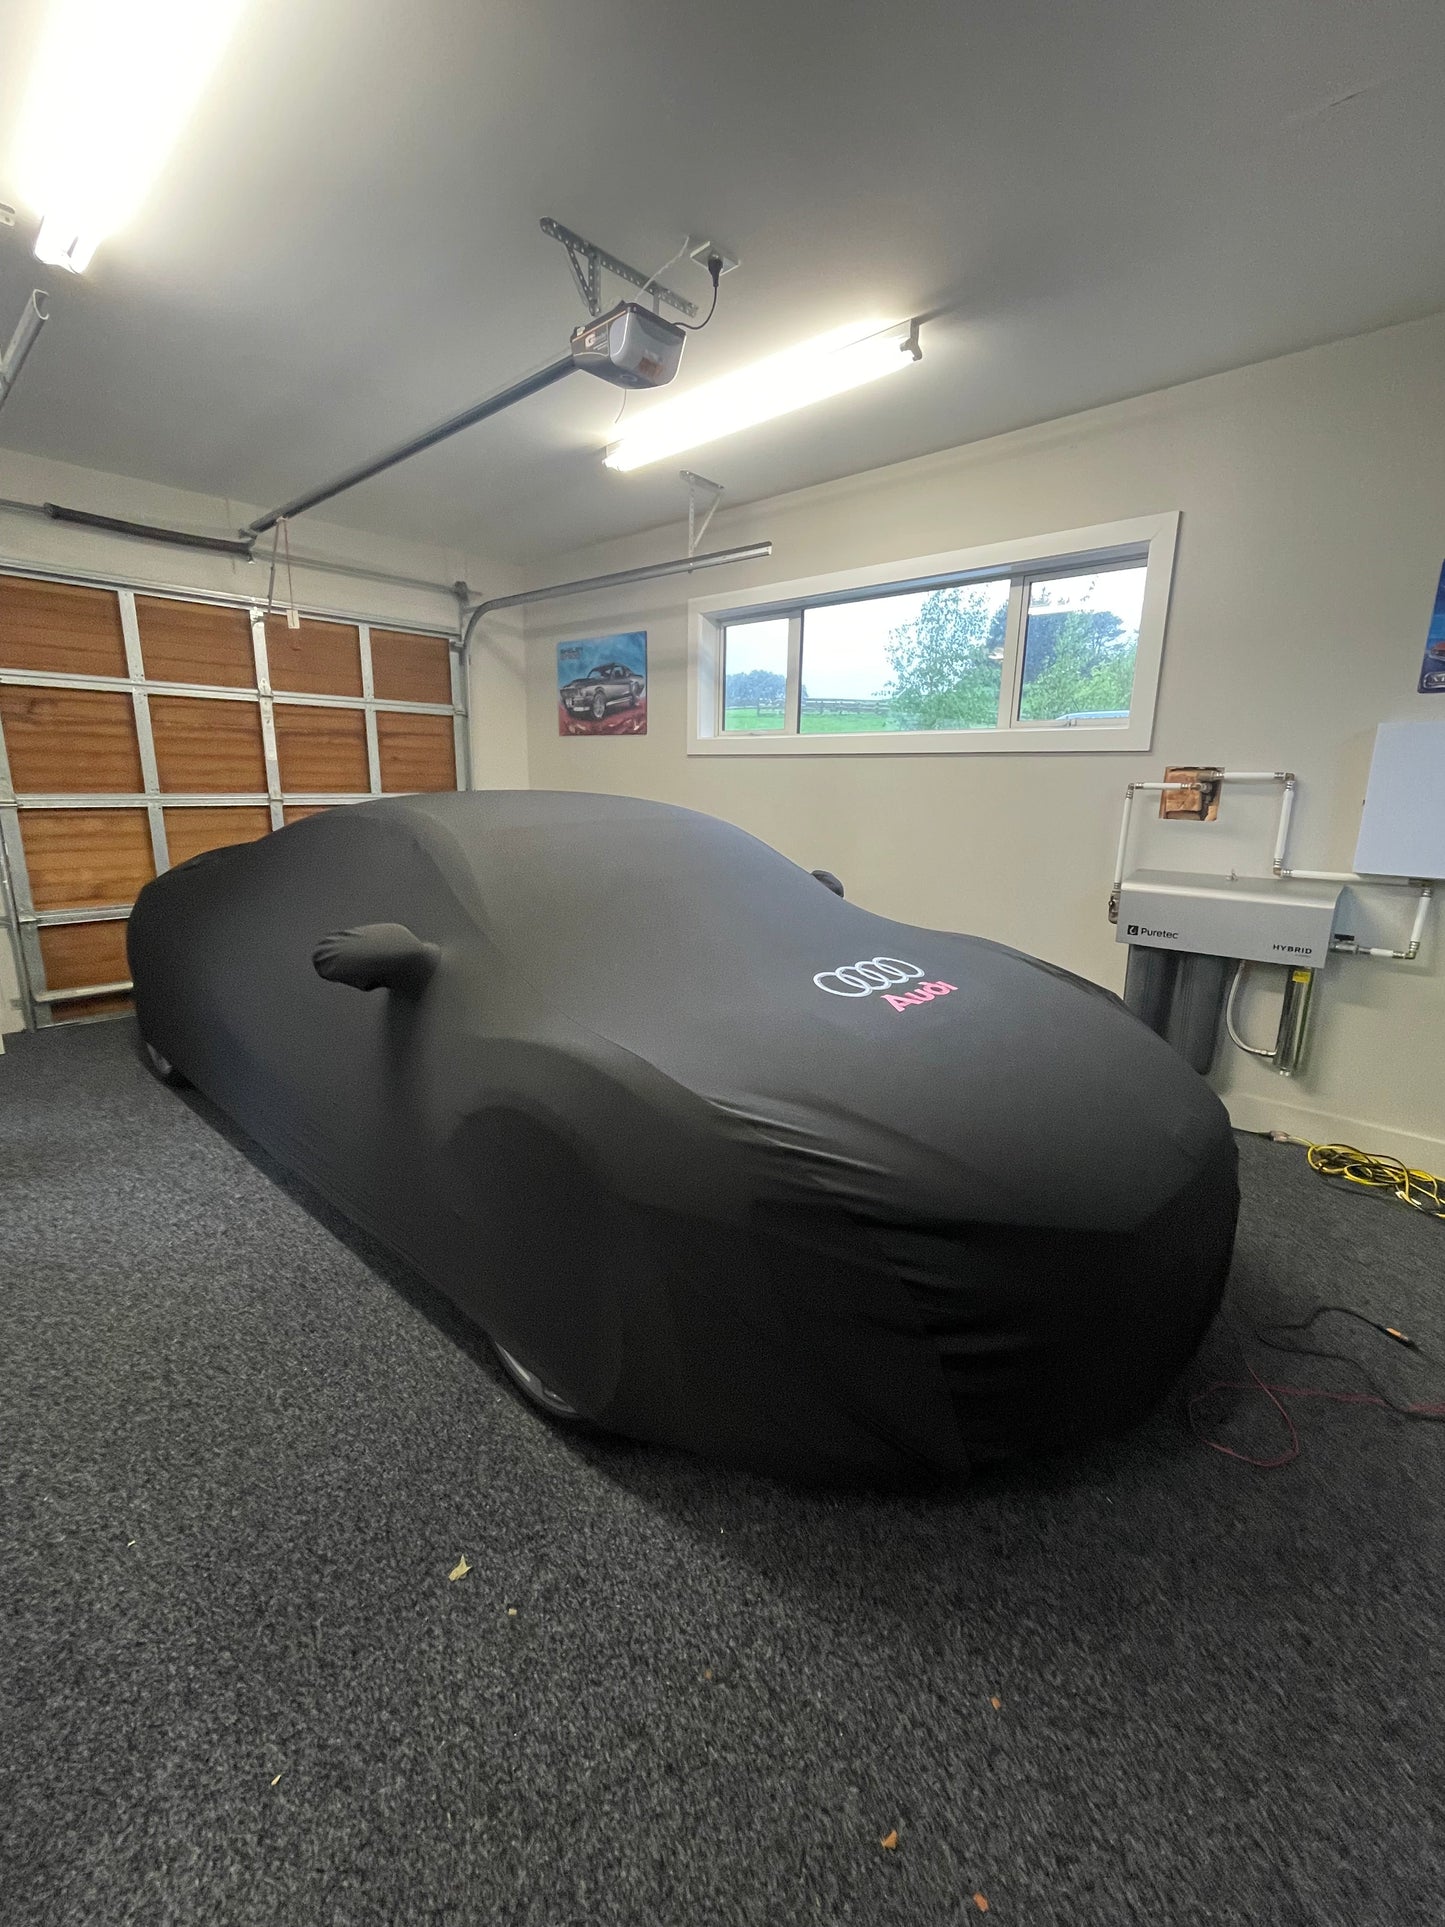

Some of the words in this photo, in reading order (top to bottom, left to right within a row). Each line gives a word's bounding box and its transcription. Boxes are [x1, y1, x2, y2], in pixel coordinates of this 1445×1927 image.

[1141, 927, 1179, 939] Puretec
[1273, 944, 1312, 955] HYBRID
[880, 980, 959, 1013] Audi
